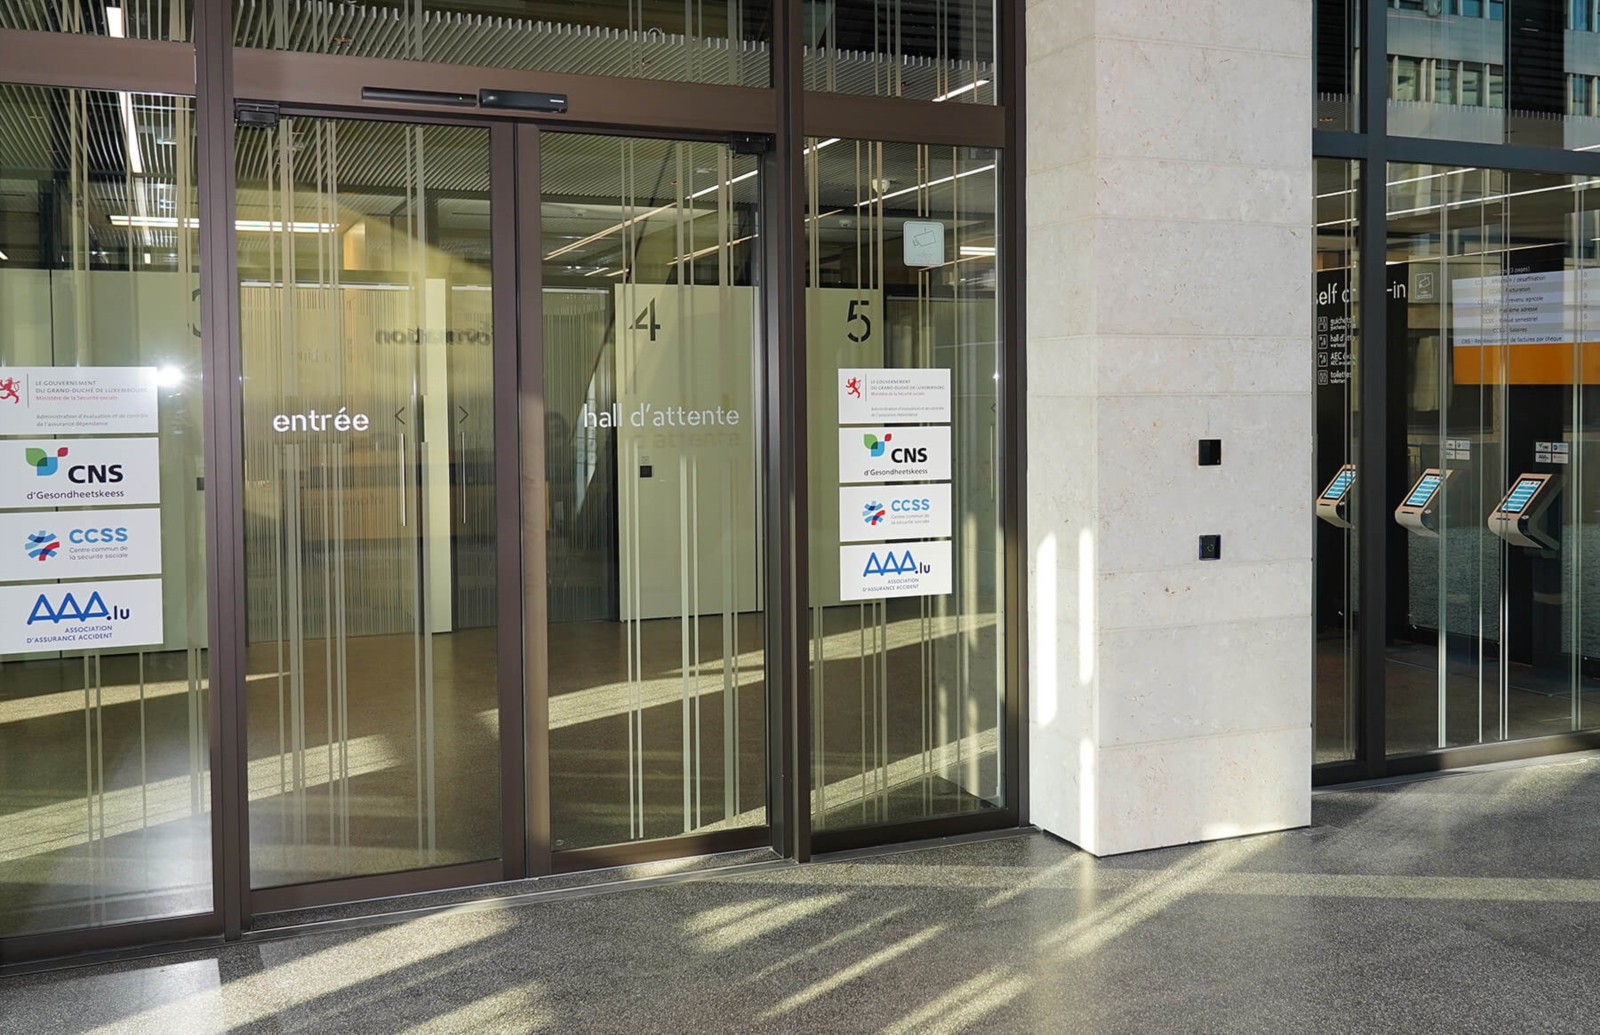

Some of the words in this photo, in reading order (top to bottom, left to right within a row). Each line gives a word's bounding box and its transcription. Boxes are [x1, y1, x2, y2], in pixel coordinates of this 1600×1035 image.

[629, 297, 661, 341] 4
[847, 300, 871, 343] 5
[273, 406, 369, 432] entrée
[583, 403, 623, 428] hall
[630, 403, 740, 427] d'attente
[891, 447, 928, 463] CNS
[67, 464, 124, 484] CNS
[864, 468, 928, 476] d'Gesondheetskeess
[26, 490, 125, 500] d'Gesondheetskeess
[891, 498, 930, 512] CCSS
[69, 527, 128, 544] CCSS
[863, 550, 931, 577] AAA.lu
[27, 591, 130, 625] AAA.lu
[27, 635, 76, 644] D'ASSURANCE
[78, 632, 113, 641] ACCIDENT
[65, 625, 113, 633] ASSOCIATION
